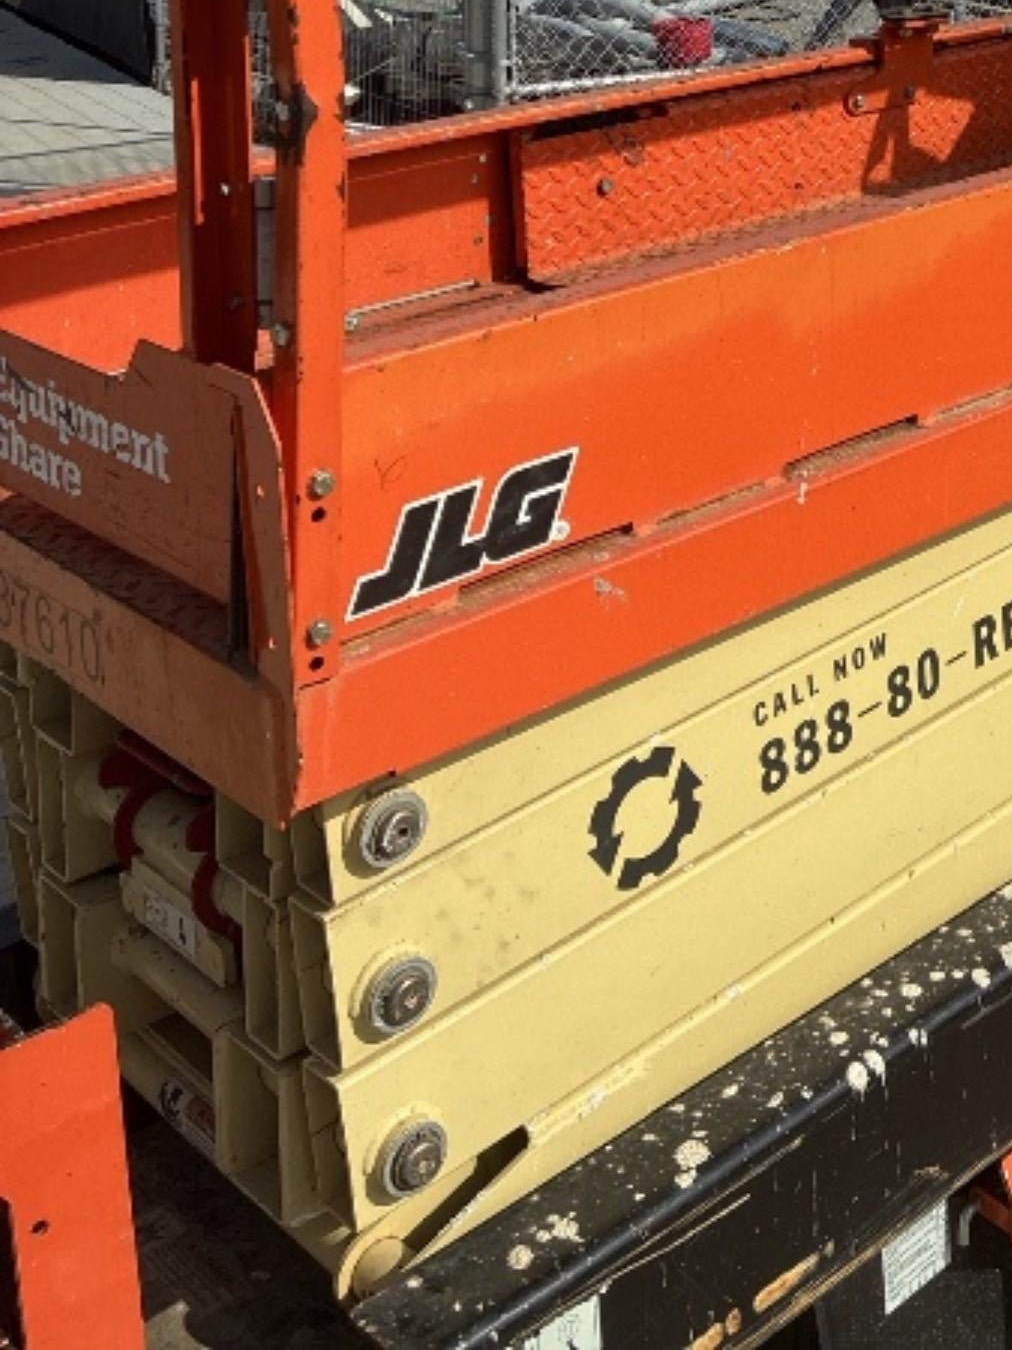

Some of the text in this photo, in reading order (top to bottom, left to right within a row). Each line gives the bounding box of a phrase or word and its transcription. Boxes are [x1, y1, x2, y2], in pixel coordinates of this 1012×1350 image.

[344, 447, 579, 623] JLG
[753, 632, 888, 726] CALL NOW
